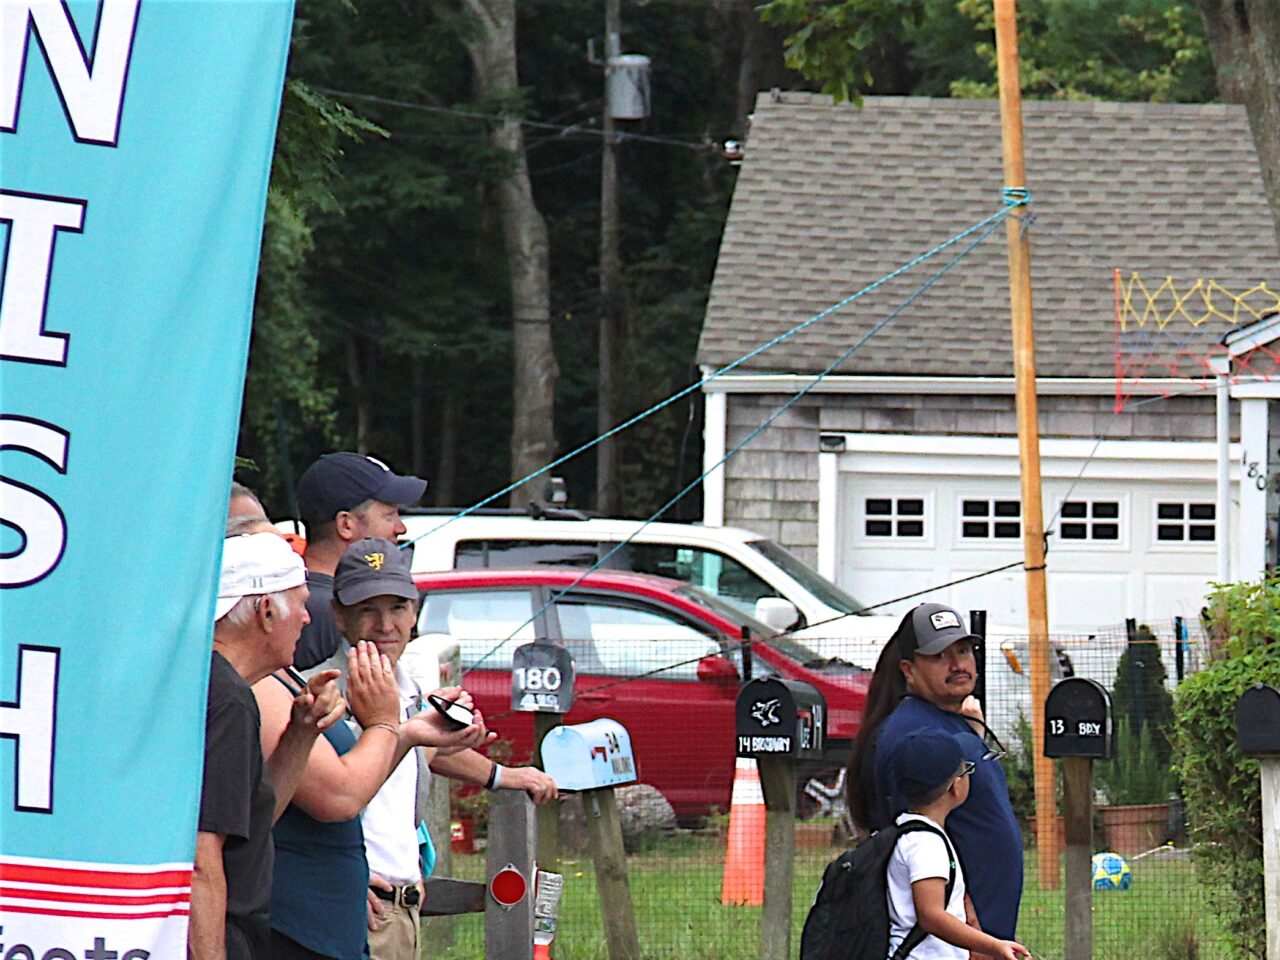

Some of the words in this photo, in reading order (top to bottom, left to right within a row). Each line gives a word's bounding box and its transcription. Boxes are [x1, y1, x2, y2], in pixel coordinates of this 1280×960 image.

[1242, 450, 1267, 491] 180
[514, 666, 561, 691] 180
[1050, 719, 1065, 735] 13
[739, 737, 751, 753] 14
